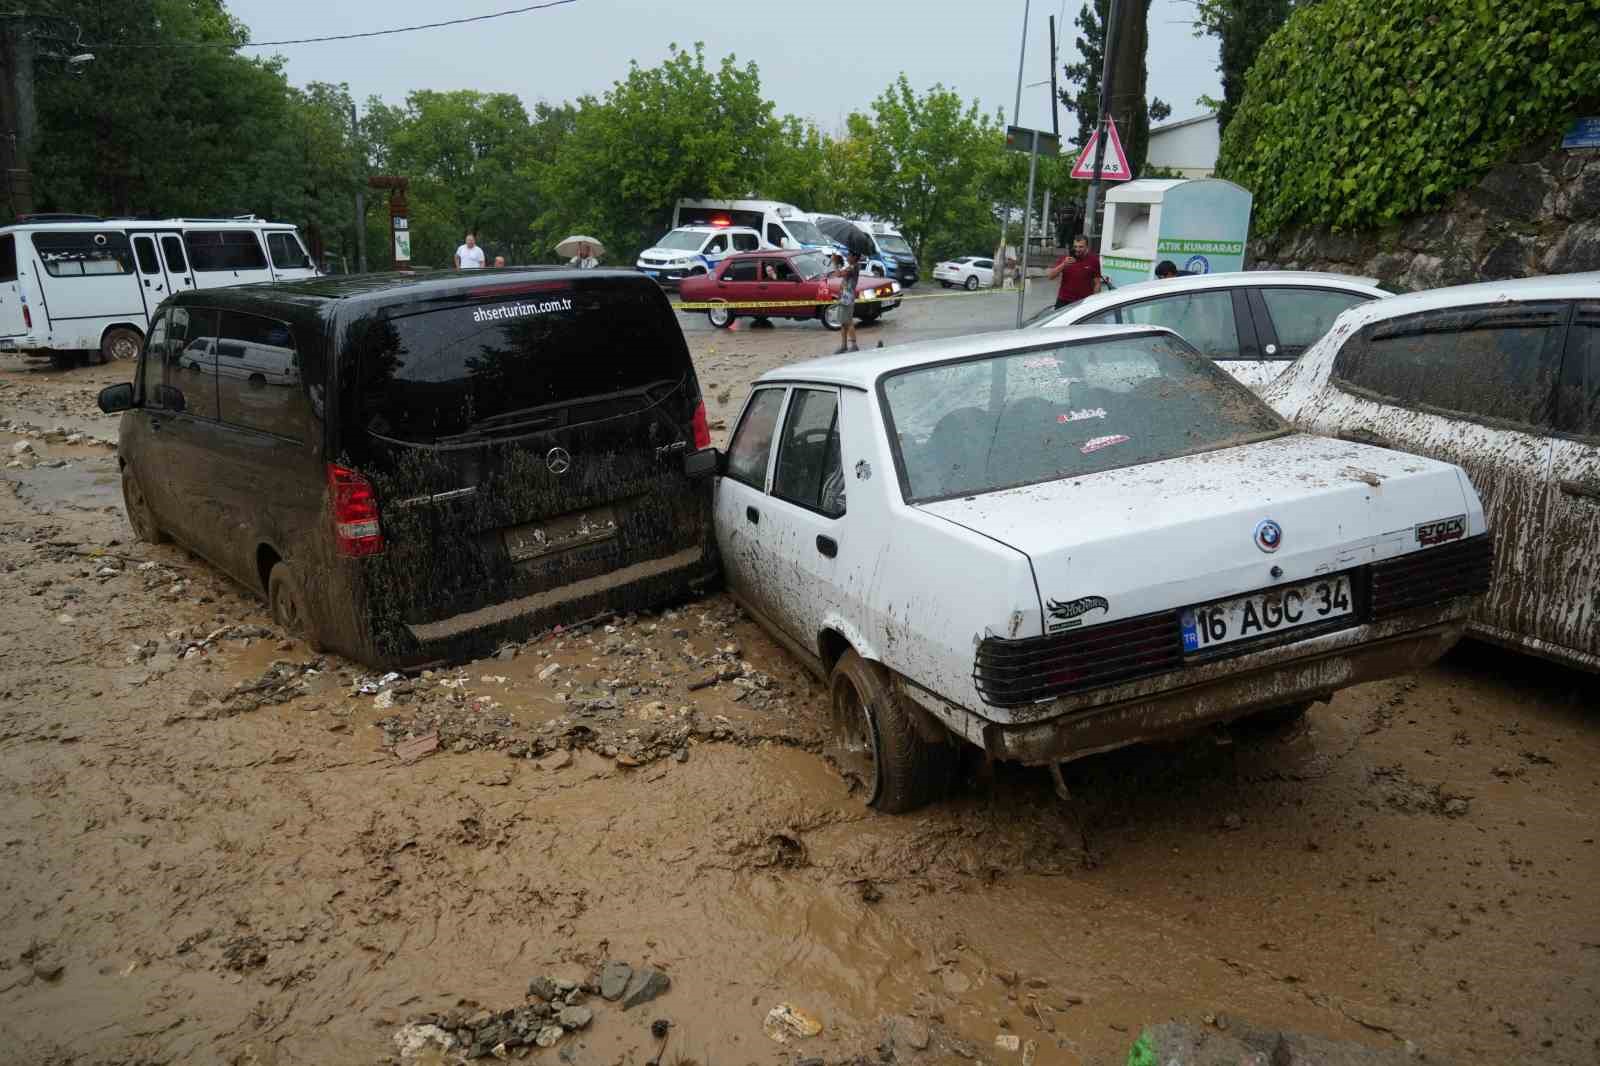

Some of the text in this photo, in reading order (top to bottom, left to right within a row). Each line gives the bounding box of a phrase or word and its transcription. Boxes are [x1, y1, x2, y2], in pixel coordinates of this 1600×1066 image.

[1158, 242, 1241, 253] ATIK KUMBARASI
[473, 298, 572, 322] ahserturizm.com.tr
[1199, 580, 1348, 643] 16 AGC 34
[1184, 634, 1197, 643] TR
